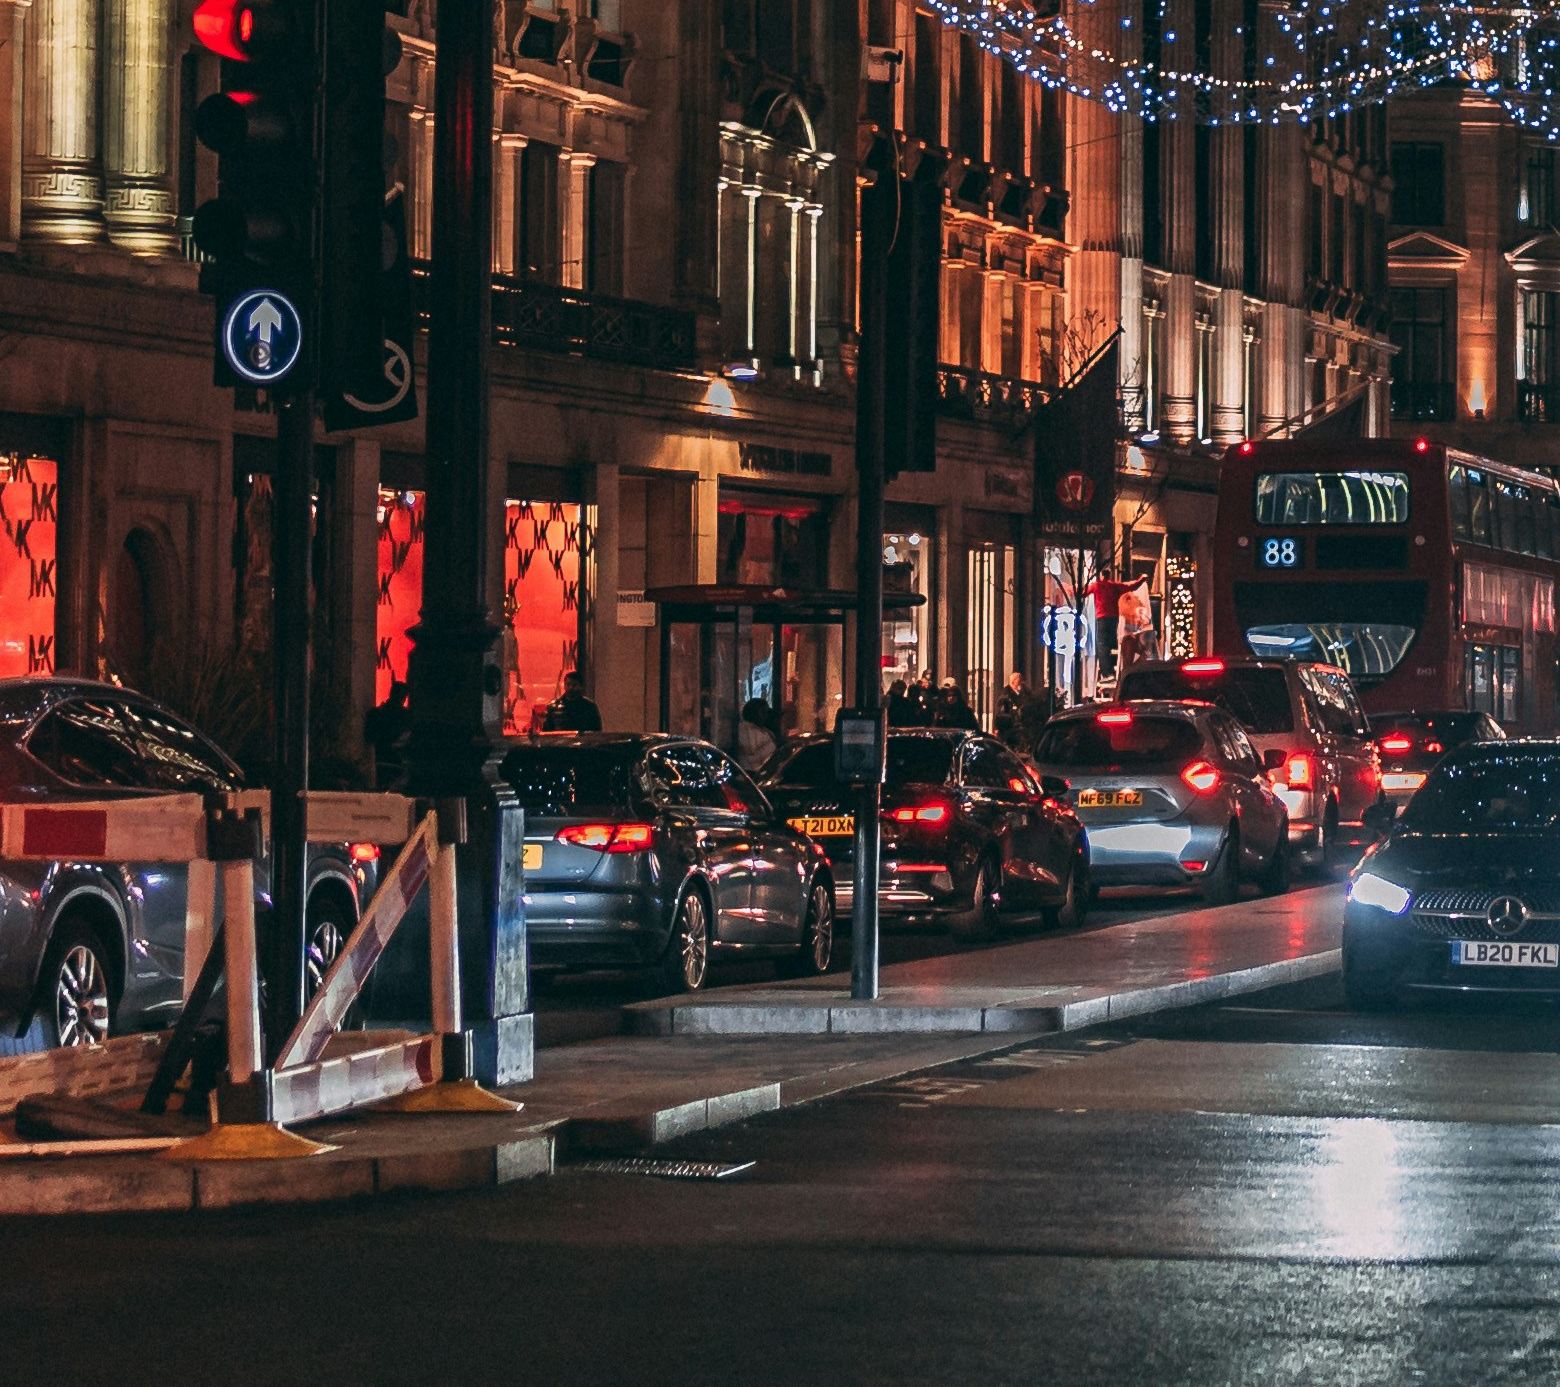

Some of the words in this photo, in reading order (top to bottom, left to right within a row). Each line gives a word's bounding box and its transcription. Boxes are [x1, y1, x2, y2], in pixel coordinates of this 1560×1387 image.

[32, 482, 57, 522] MK
[1264, 537, 1296, 566] 88
[29, 558, 56, 599] MK
[28, 634, 54, 674] MK
[1464, 944, 1513, 963] LB20
[1518, 945, 1555, 963] FKL
